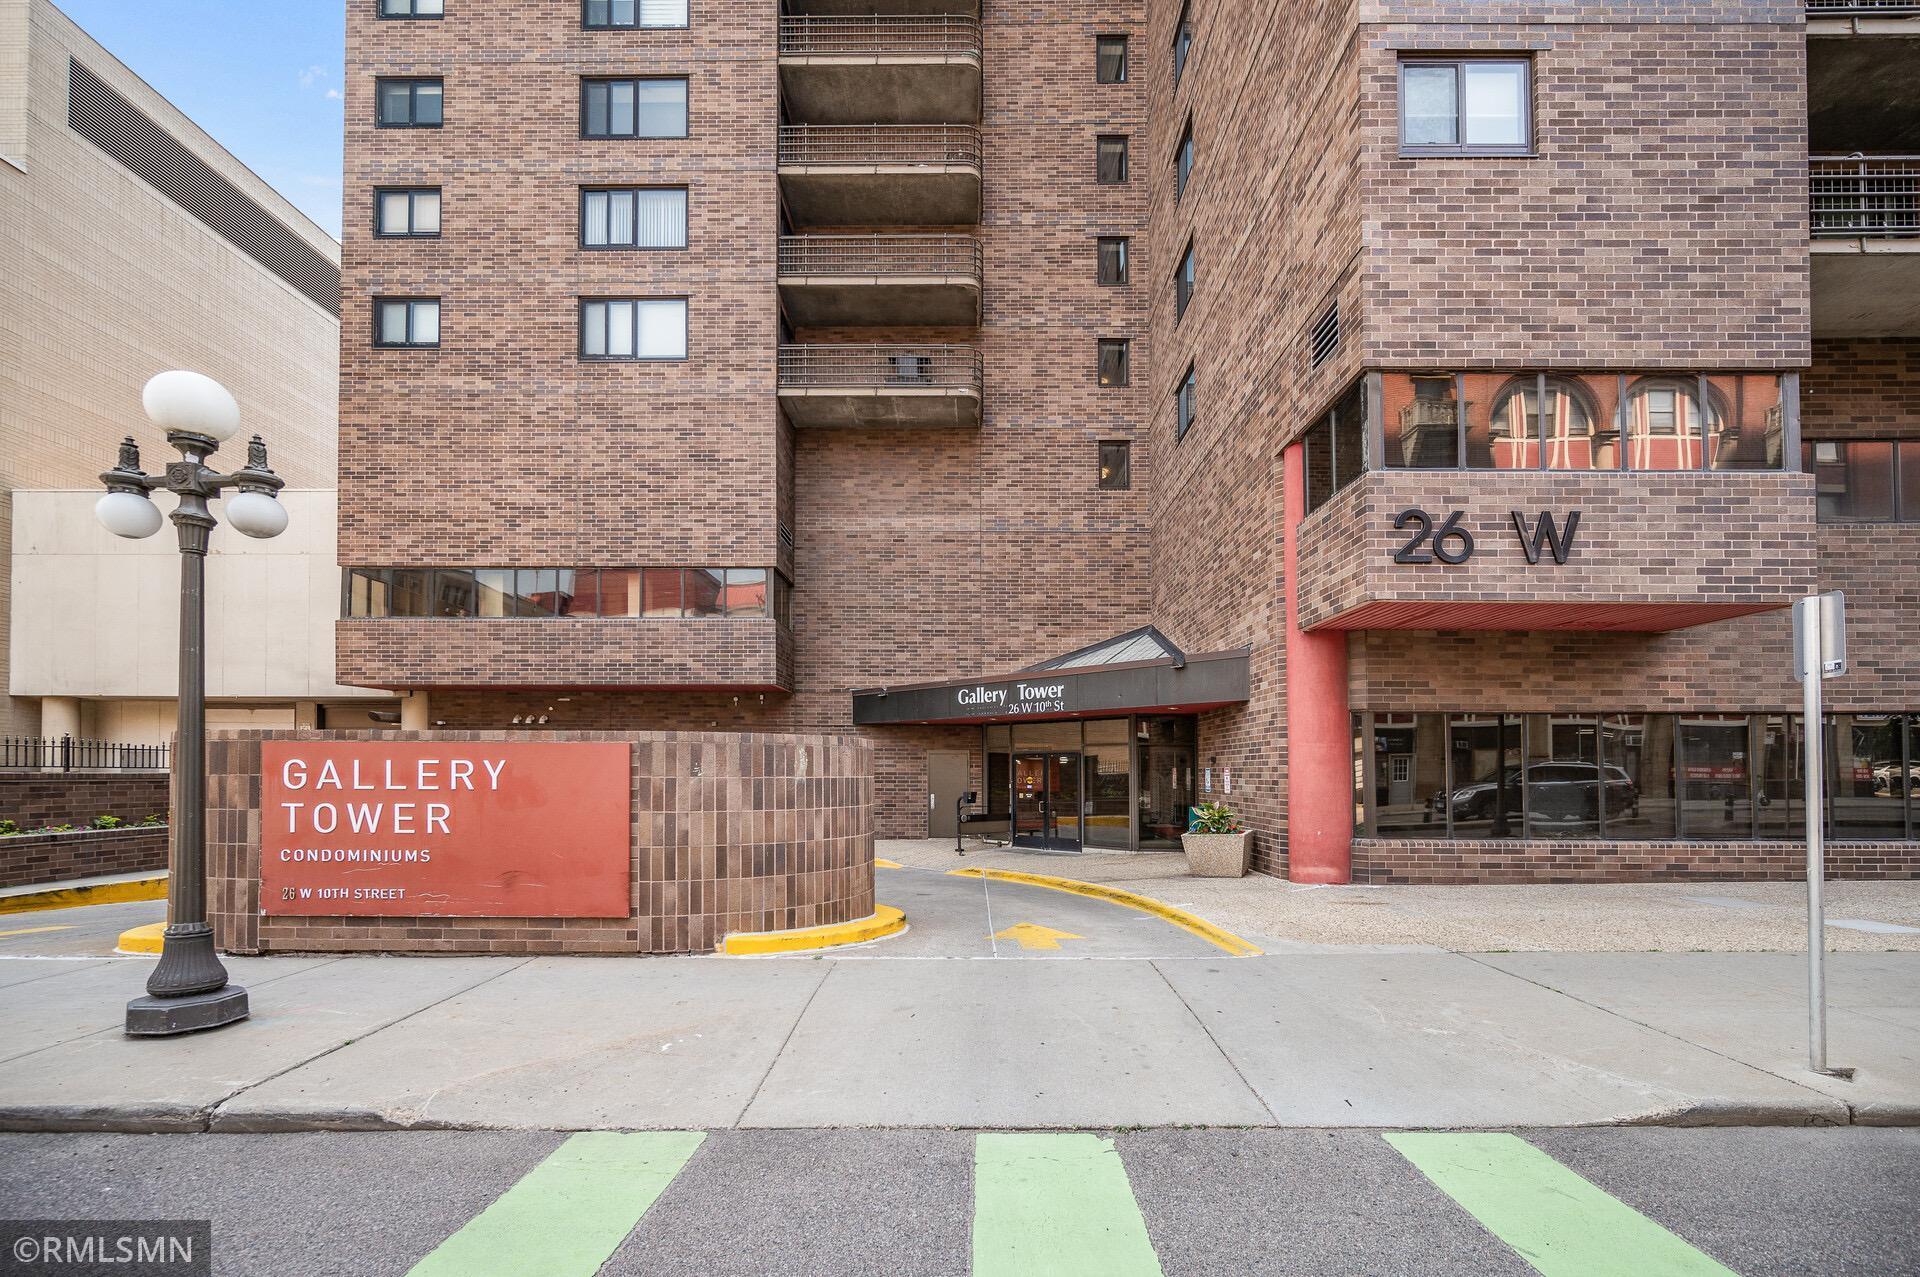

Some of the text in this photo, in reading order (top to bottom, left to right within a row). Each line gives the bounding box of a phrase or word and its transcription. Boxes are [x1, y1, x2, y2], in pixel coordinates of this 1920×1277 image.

[1394, 508, 1581, 565] 26 W
[957, 683, 1065, 707] Gallery Tower
[1008, 700, 1065, 714] 26 W 10th St
[282, 758, 507, 790] GALLERY
[281, 802, 451, 834] TOWER
[280, 849, 431, 863] CONDOMINIUMS
[282, 887, 406, 900] 26 W 10TH STREET
